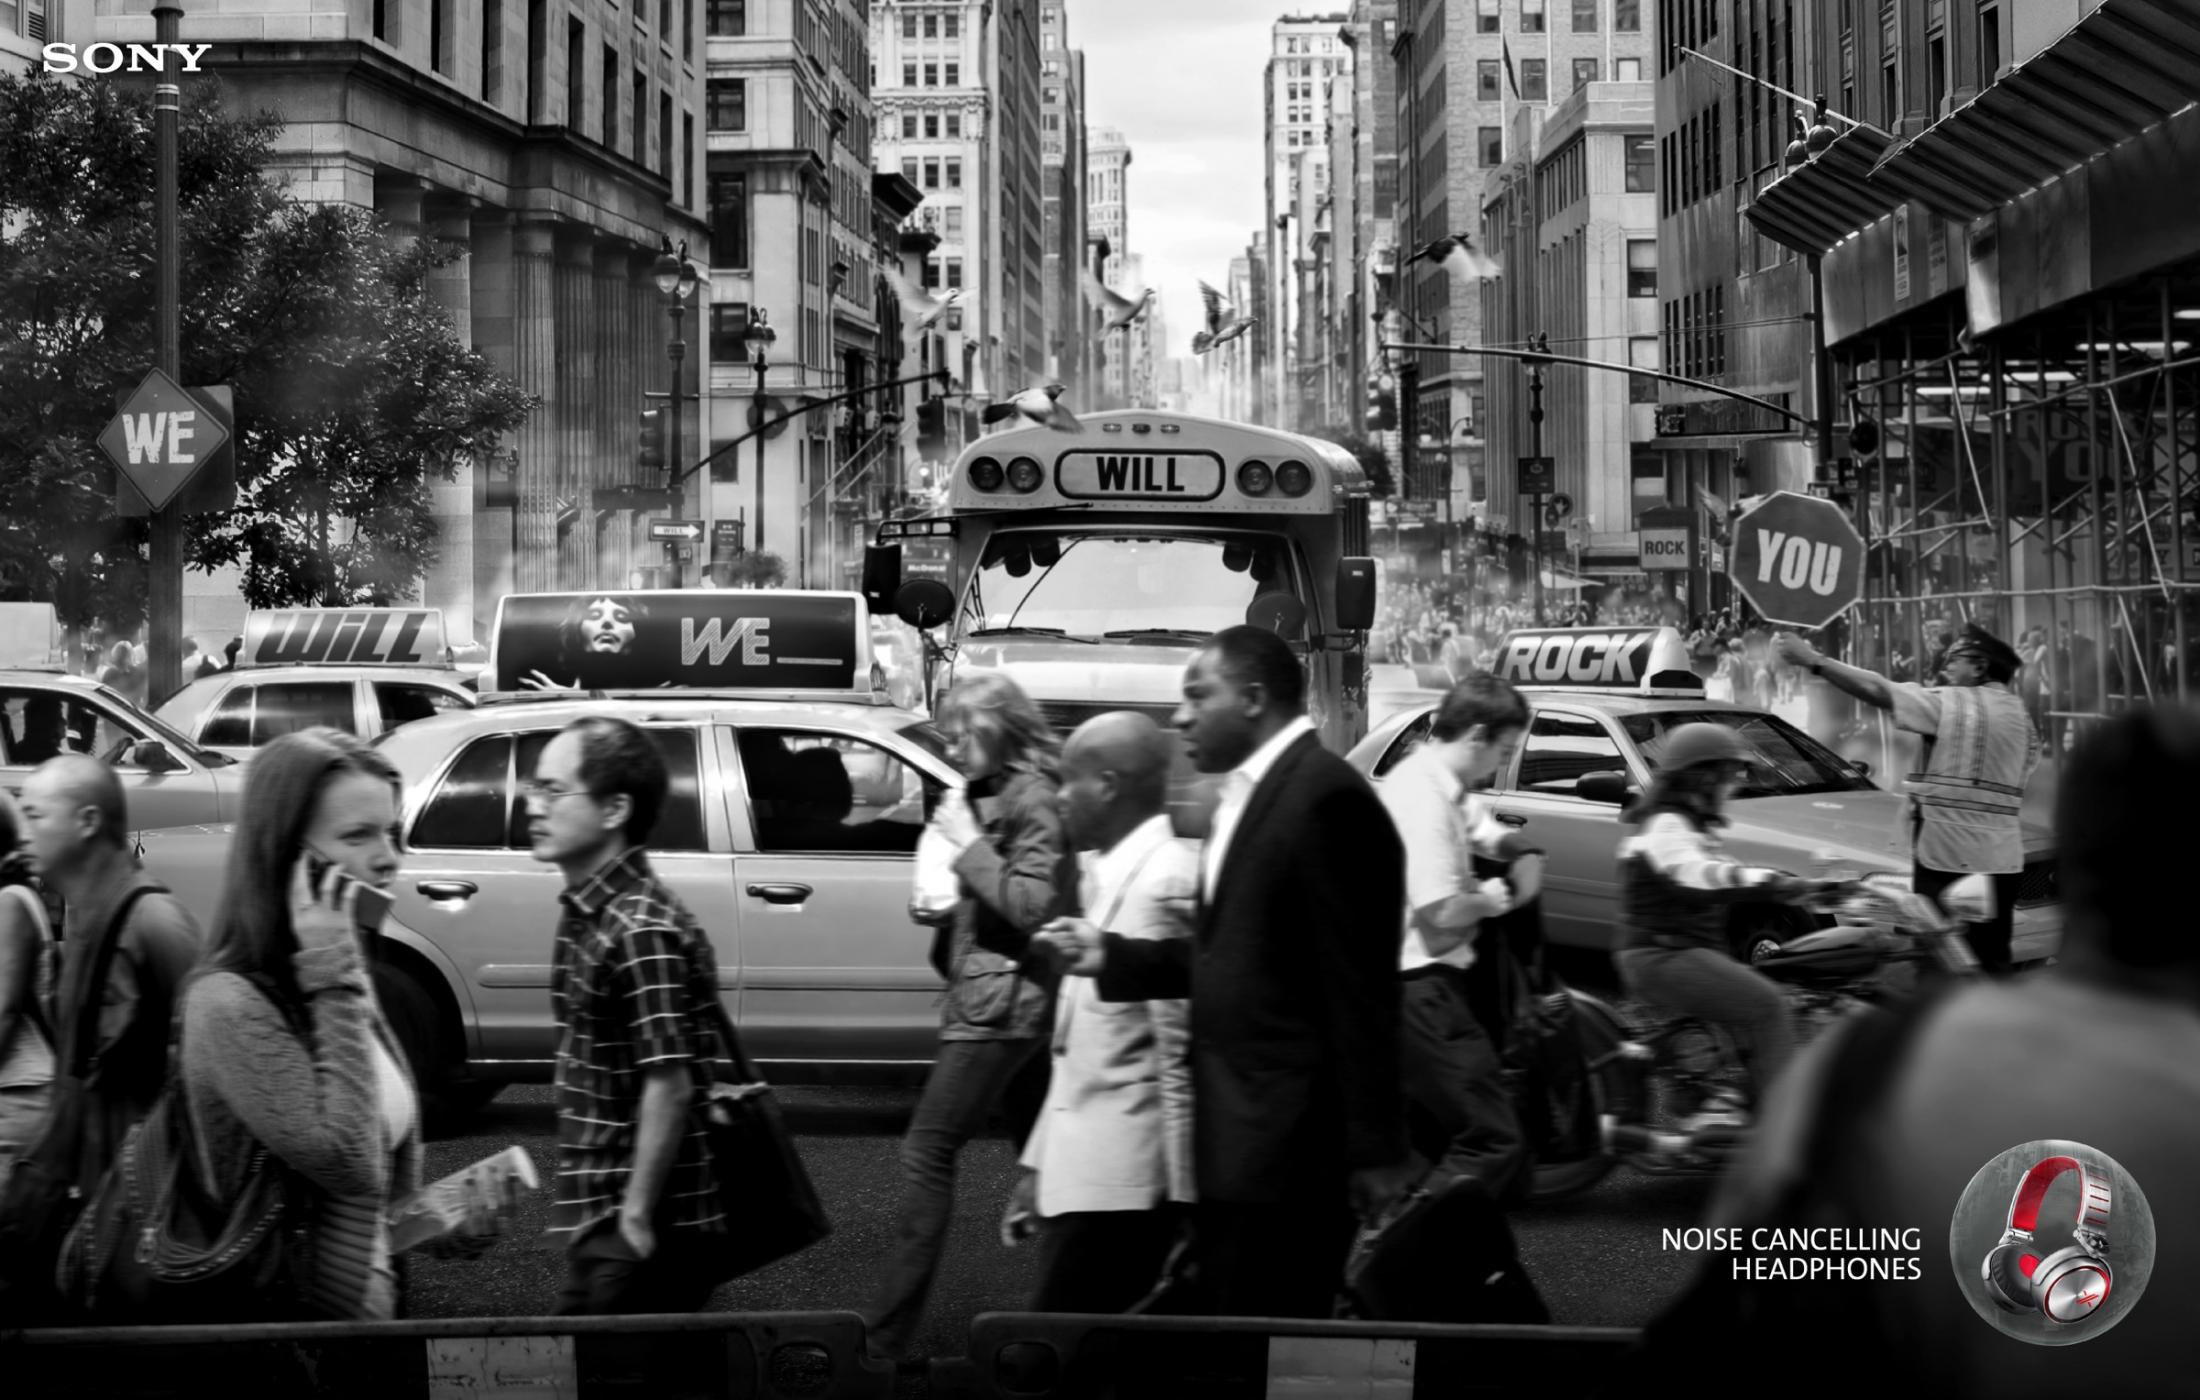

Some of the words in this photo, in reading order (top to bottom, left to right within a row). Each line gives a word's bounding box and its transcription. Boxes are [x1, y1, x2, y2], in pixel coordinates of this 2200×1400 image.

[122, 410, 195, 464] WE
[1095, 456, 1185, 492] WILL
[1644, 540, 1685, 556] ROCK
[1757, 528, 1842, 596] YOU
[1500, 632, 1654, 682] ROCK
